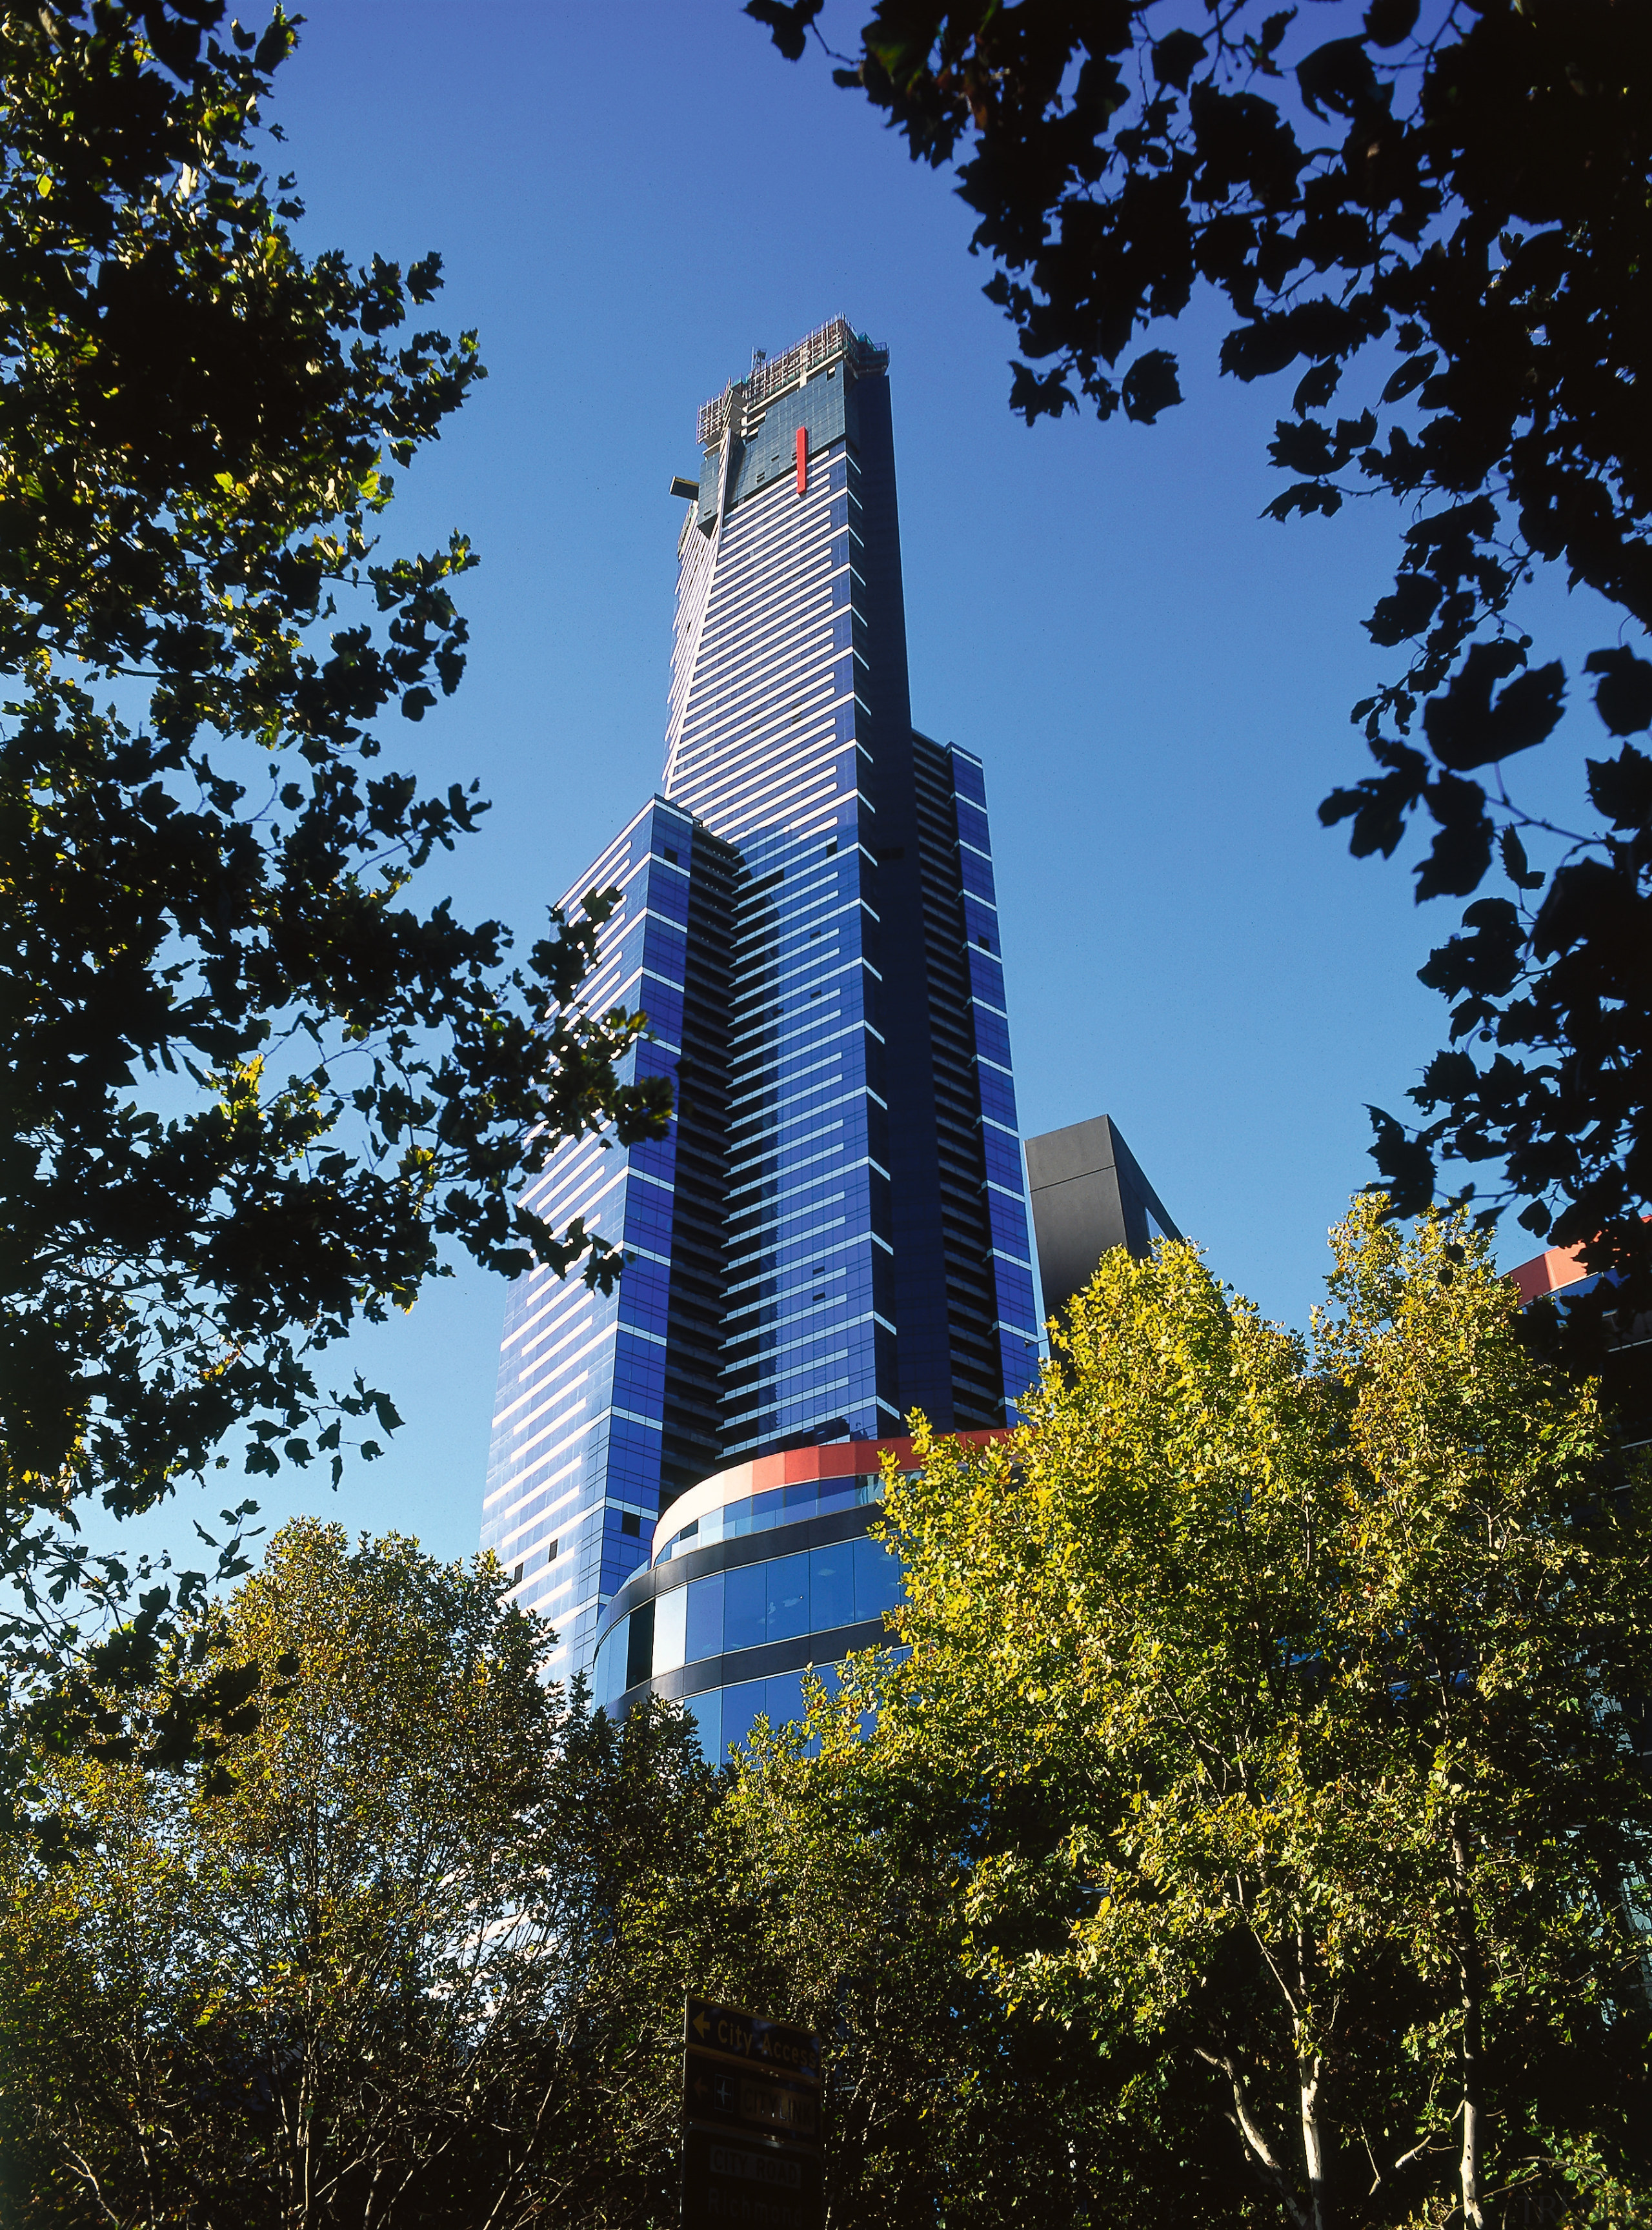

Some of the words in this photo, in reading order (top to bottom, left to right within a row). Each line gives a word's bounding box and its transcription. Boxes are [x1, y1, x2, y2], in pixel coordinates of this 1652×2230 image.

[718, 2020, 752, 2056] City
[761, 2033, 816, 2069] Access
[743, 2087, 811, 2126] CITYLINK
[714, 2149, 747, 2174] CITY
[756, 2158, 798, 2184] ROAD
[708, 2187, 803, 2227] Richmond
